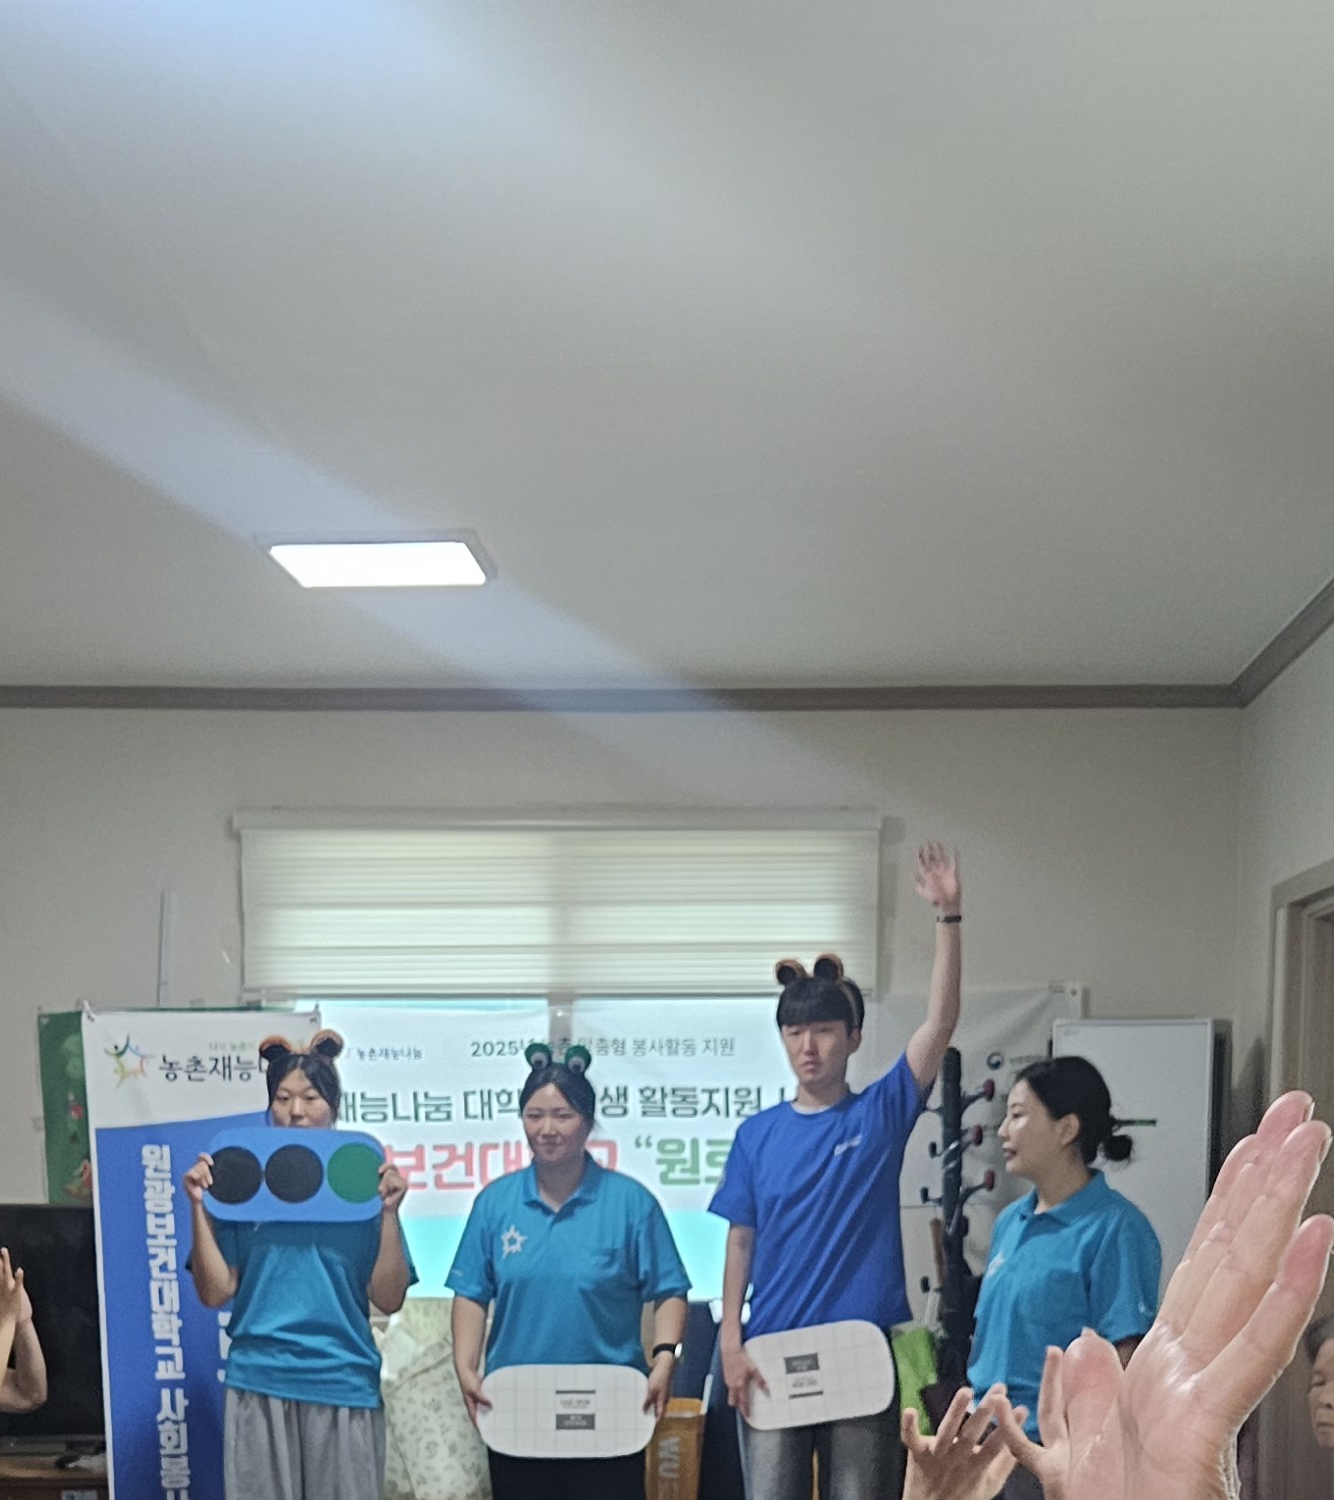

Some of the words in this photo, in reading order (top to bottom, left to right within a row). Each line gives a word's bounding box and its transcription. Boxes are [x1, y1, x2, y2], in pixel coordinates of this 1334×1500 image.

[633, 1037, 697, 1057] 봉사활동
[702, 1037, 735, 1057] 지원
[159, 1054, 267, 1083] 농촌재능
[638, 1085, 762, 1119] 활동지원
[141, 1143, 186, 1381] 원광보건대학교
